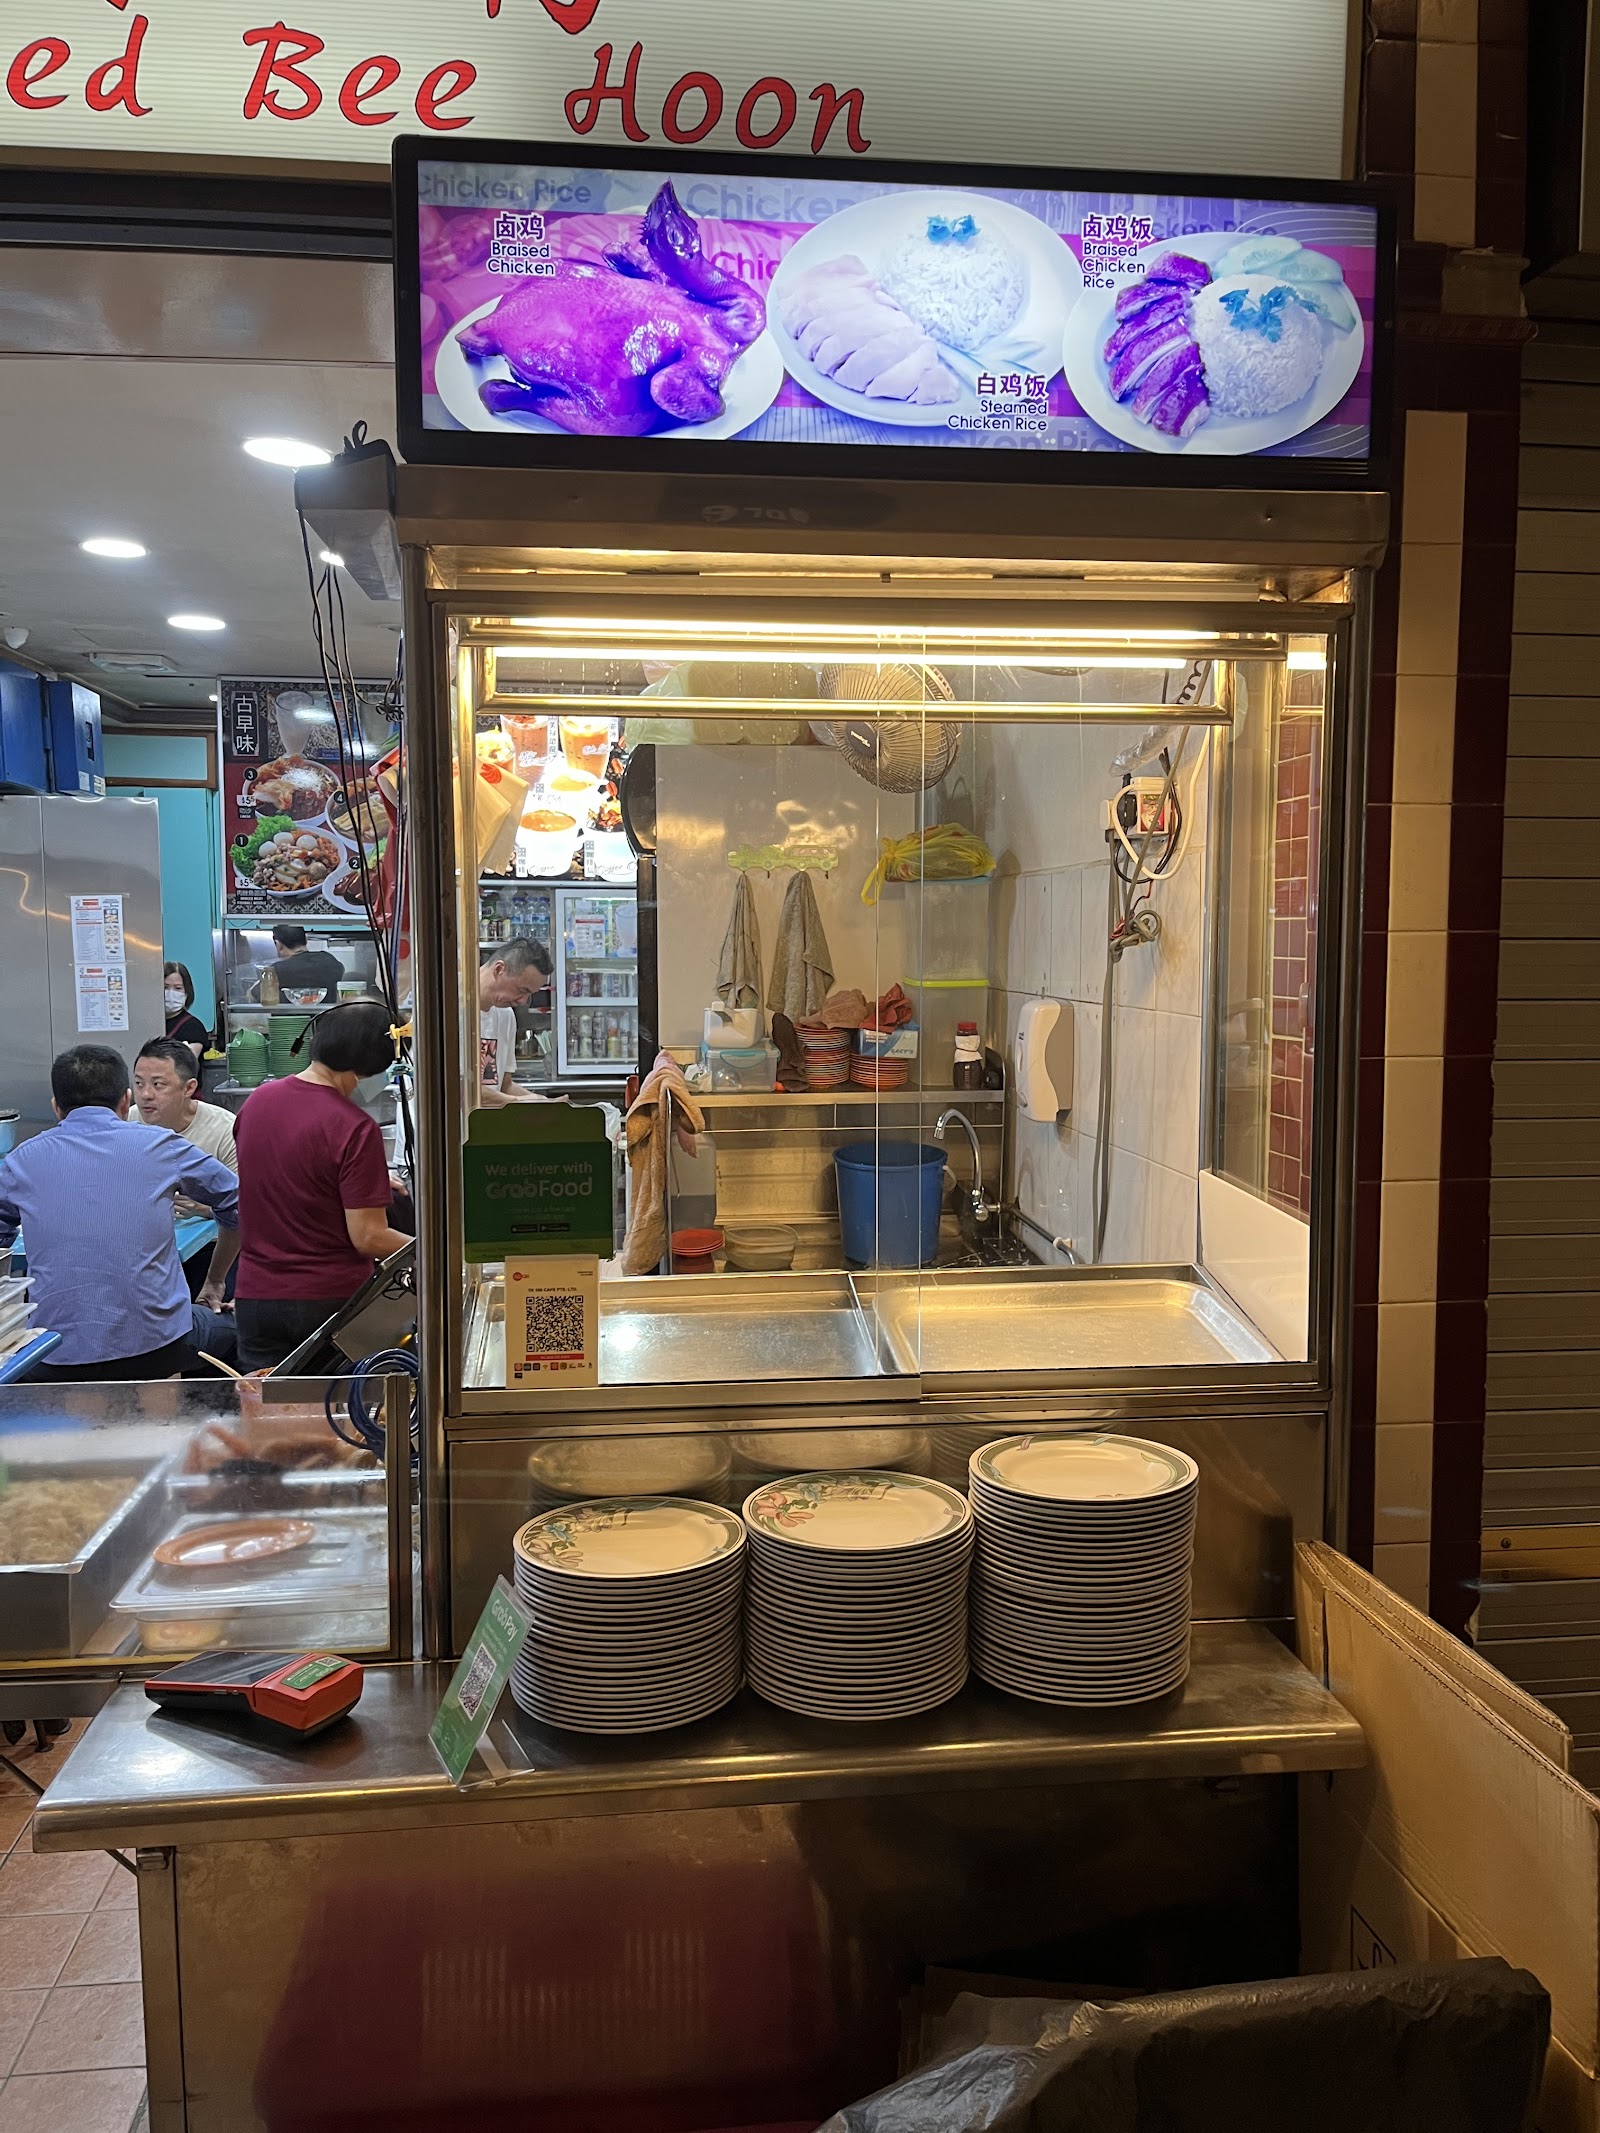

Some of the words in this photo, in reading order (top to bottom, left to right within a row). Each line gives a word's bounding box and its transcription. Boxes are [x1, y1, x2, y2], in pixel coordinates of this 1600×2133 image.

[5, 14, 153, 117] ed
[242, 21, 477, 131] Bee
[564, 41, 872, 155] Hoon
[534, 178, 591, 203] Rice
[495, 213, 544, 241] 卤鸡
[1083, 214, 1152, 240] 卤鸡饭
[492, 242, 549, 258] Braised
[1084, 243, 1138, 257] Braised
[488, 259, 554, 276] Chicken
[1083, 260, 1145, 274] Chicken
[1083, 276, 1115, 289] Rice
[977, 372, 1047, 398] 白鸡饭
[980, 400, 1047, 415] Steamed
[948, 415, 1010, 431] Chicken
[1015, 416, 1047, 431] Rice
[235, 694, 254, 753] 古早味
[247, 770, 254, 779] 3
[337, 794, 344, 802] 4
[239, 836, 245, 845] 1
[352, 859, 359, 868] 2
[484, 1164, 508, 1176] We
[511, 1162, 559, 1176] deliver
[563, 1161, 593, 1174] with
[485, 1176, 593, 1199] GrabFood
[491, 1599, 519, 1643] GrabPay
